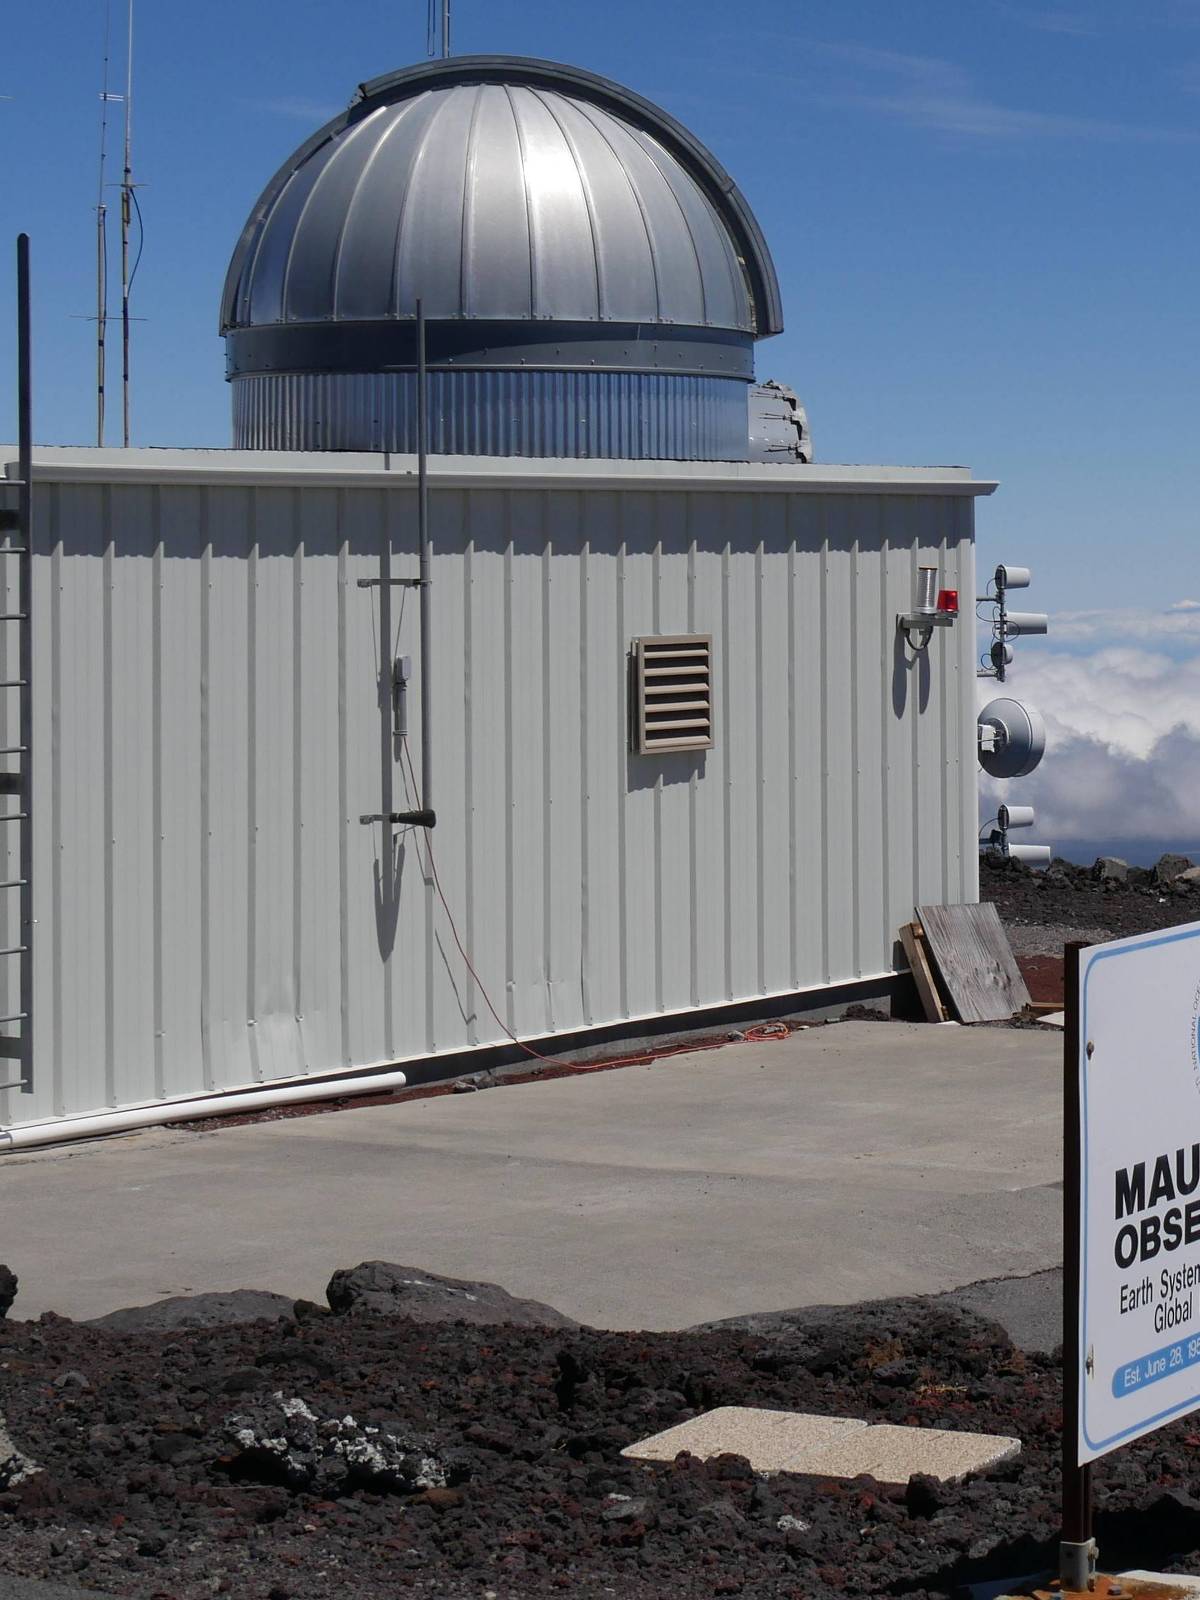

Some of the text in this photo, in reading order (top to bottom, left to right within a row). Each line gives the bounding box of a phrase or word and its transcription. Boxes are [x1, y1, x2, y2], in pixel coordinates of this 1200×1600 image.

[1120, 1275, 1153, 1314] Earth
[1154, 1291, 1193, 1334] Global
[1123, 1365, 1142, 1388] Est.
[1144, 1356, 1166, 1379] June
[1169, 1346, 1184, 1369] 28,
